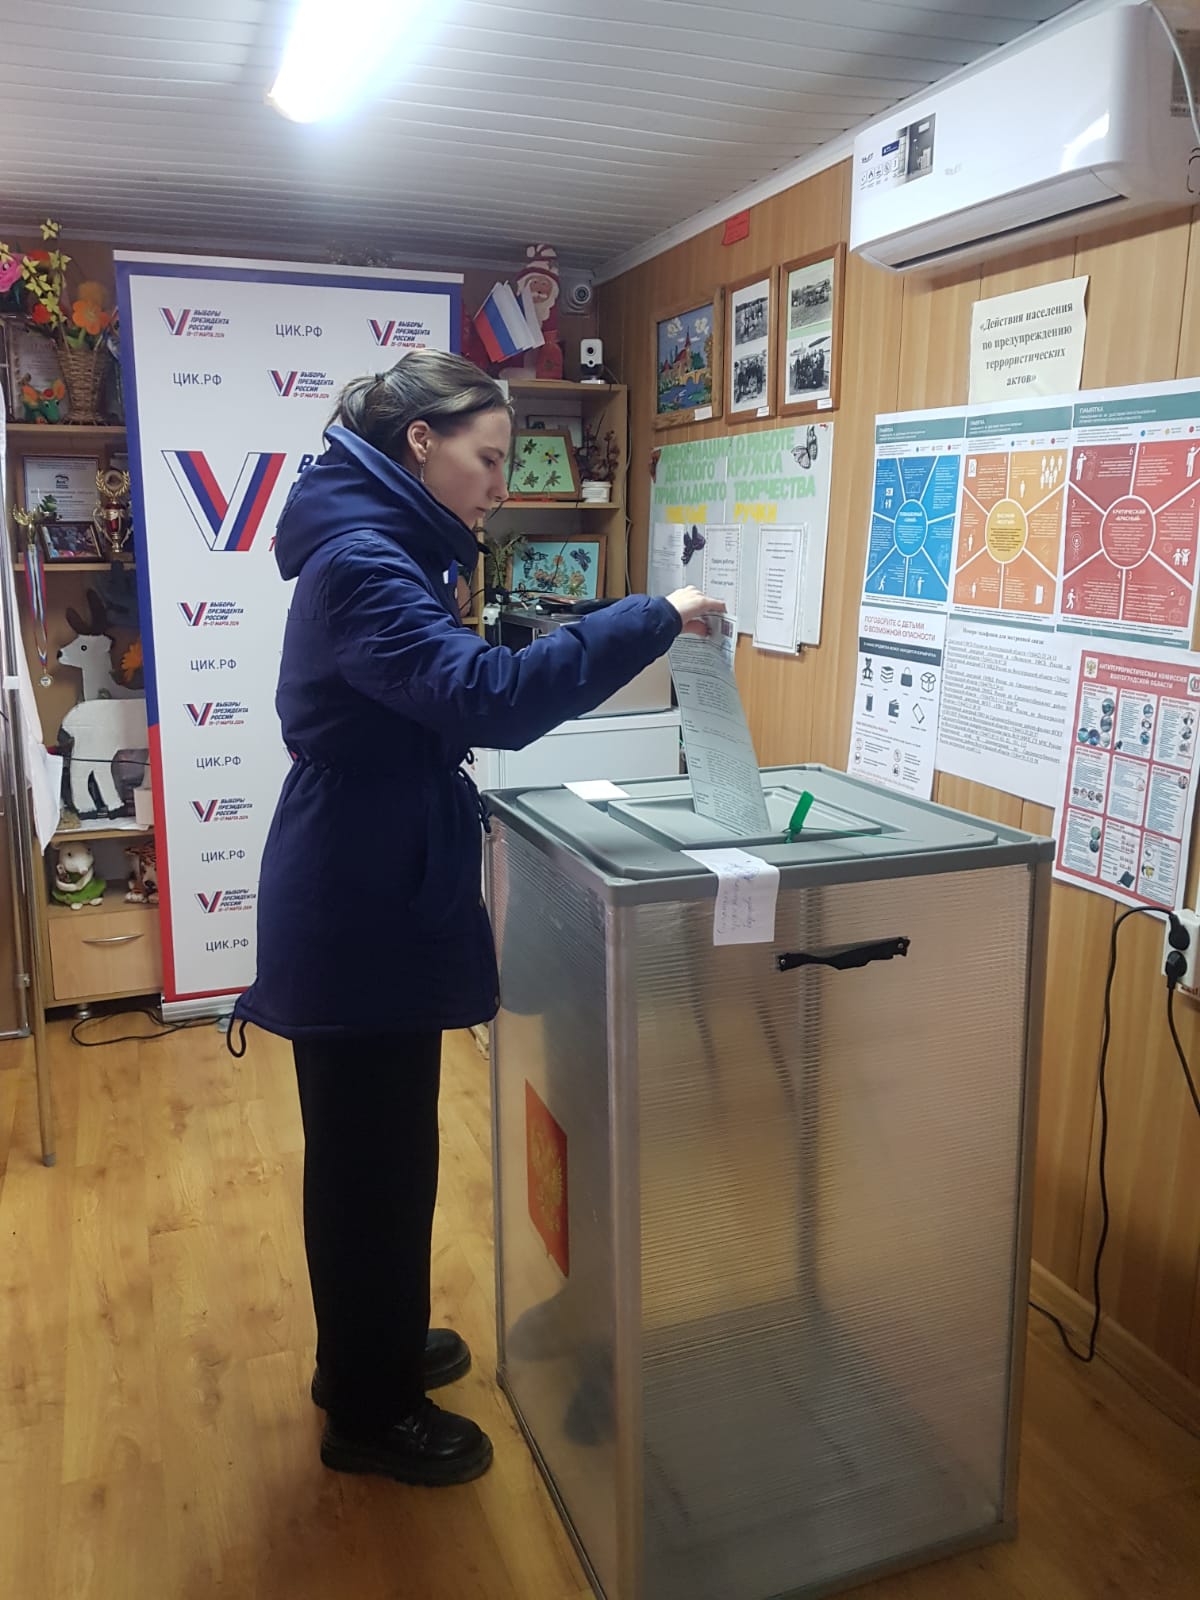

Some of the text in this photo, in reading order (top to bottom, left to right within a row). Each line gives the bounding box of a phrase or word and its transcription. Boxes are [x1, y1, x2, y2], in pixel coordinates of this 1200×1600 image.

[190, 317, 230, 325] ПРЕЗИДЕНТА
[980, 302, 1073, 331] «Действия населения
[275, 323, 323, 338] ЦИК.РФ
[395, 328, 431, 336] ПРЕЗИДЕНТА
[982, 325, 1072, 351] по предупреждению
[986, 347, 1066, 371] террористических
[173, 372, 222, 387] ЦИК.РФ
[300, 371, 327, 379] ВЫБОРЫ
[1006, 374, 1037, 386] актов»
[665, 452, 783, 484] ДЕТСКОГО КРУЖКА
[654, 475, 815, 504] ПРИКЛАДНОГО ТВОРЧЕСТВА
[733, 503, 778, 524] РУЧКИ
[190, 658, 237, 672] ЦИК.РФ
[196, 755, 242, 770] ЦИК.РФ
[201, 849, 245, 863] ЦИК.РФ
[206, 938, 249, 952] ЦИК.РФ
